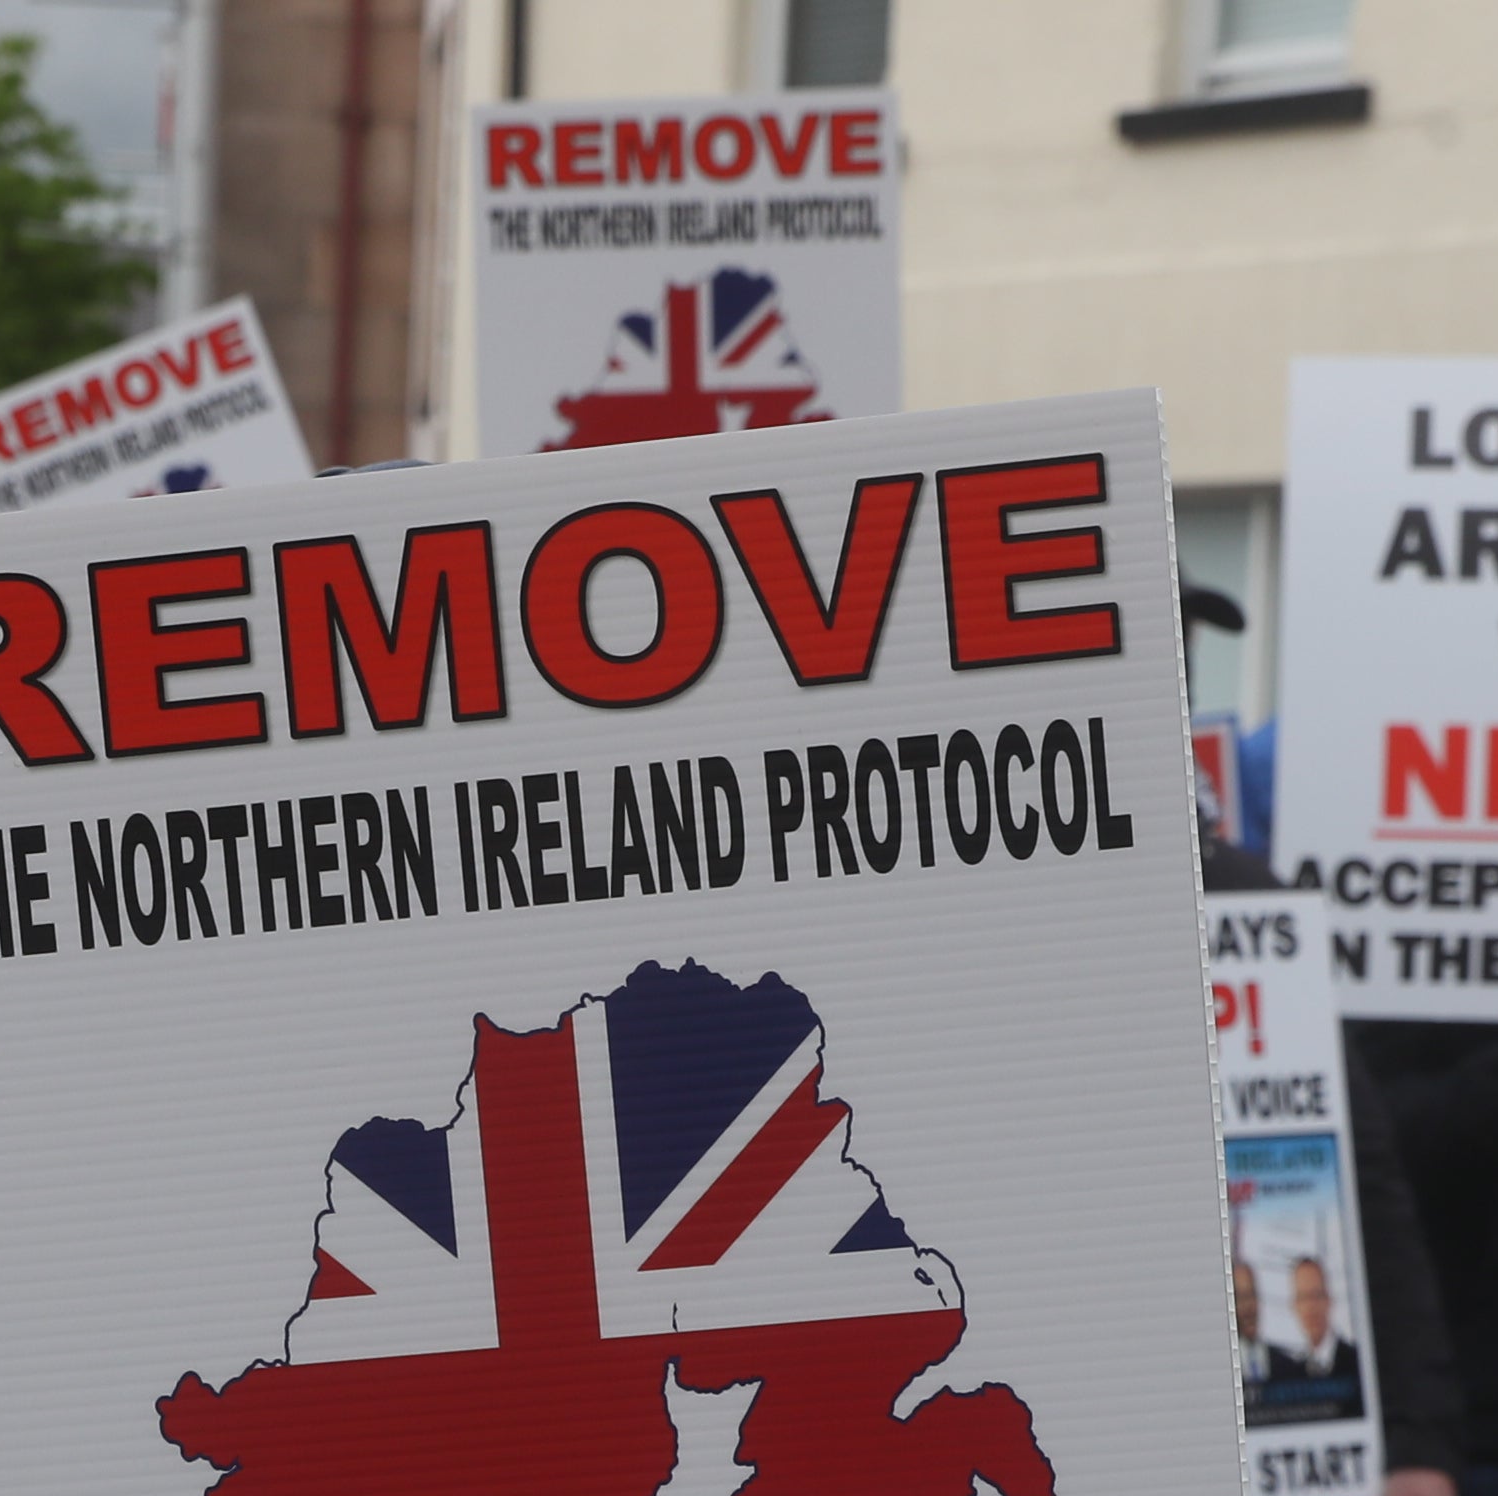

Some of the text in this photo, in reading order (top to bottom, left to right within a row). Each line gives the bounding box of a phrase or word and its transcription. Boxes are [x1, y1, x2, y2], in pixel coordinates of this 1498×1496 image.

[487, 110, 883, 190] REMOVE
[488, 205, 532, 251] THE
[542, 201, 656, 249] NORTHERN
[68, 785, 441, 950] NORTHERN
[458, 754, 746, 914] IRELAND
[768, 715, 1135, 884] PROTOCOL
[1333, 932, 1368, 982] N
[1229, 1074, 1327, 1118] VOICE
[1258, 1442, 1365, 1496] START
